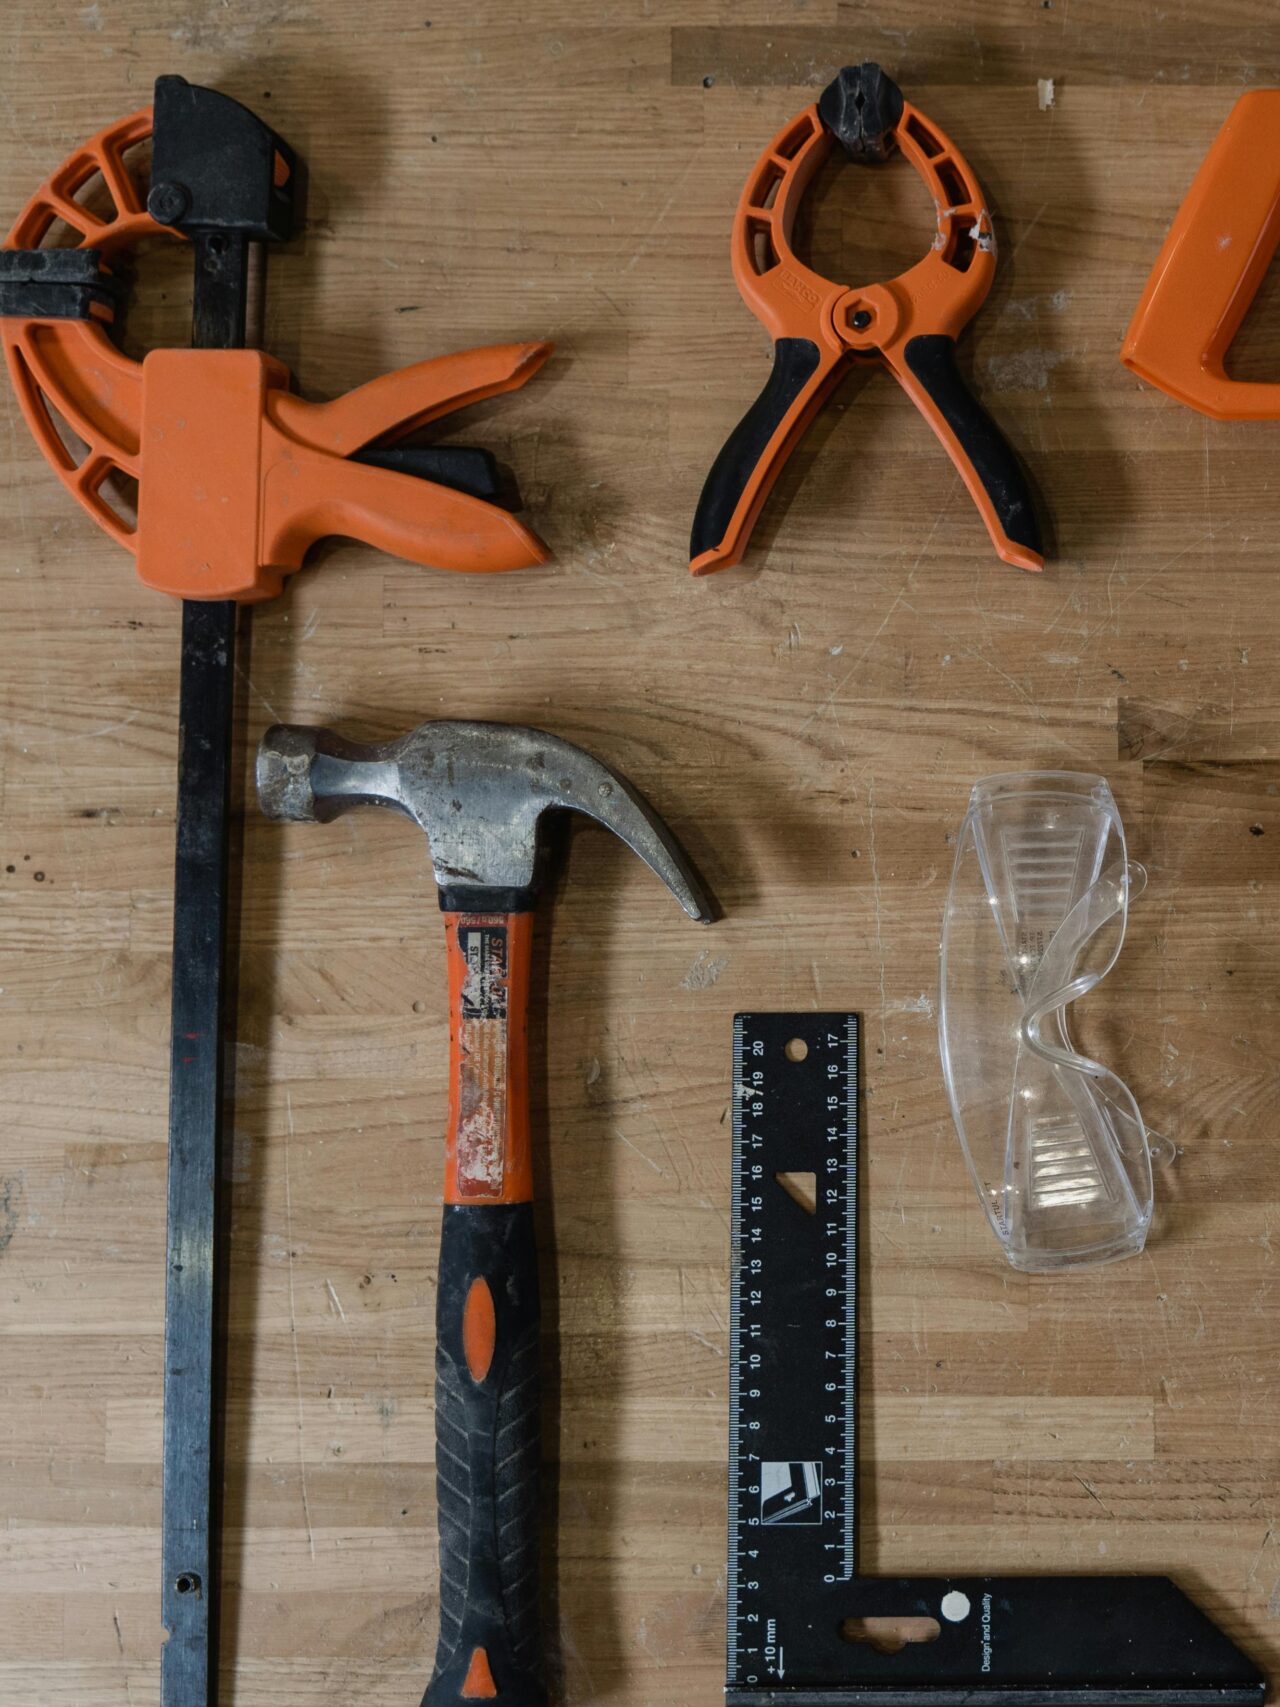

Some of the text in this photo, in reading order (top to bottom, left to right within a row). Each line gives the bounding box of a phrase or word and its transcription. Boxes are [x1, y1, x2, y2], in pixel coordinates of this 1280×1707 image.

[753, 1041, 763, 1055] 20
[828, 1034, 838, 1048] 17
[753, 1072, 763, 1086] 19
[827, 1065, 838, 1079] 16
[753, 1103, 763, 1117] 18
[827, 1096, 838, 1110] 15
[752, 1134, 762, 1148] 17
[827, 1127, 837, 1141] 14
[752, 1165, 762, 1180] 16
[827, 1158, 837, 1173] 13
[827, 1189, 837, 1204] 12
[751, 1197, 762, 1211] 15
[751, 1228, 761, 1242] 14
[827, 1223, 837, 1235] 11
[751, 1260, 761, 1274] 13
[826, 1253, 837, 1267] 10
[751, 1291, 761, 1305] 12
[825, 1319, 836, 1327] 8
[750, 1325, 760, 1337] 11
[750, 1354, 760, 1369] 10
[825, 1351, 836, 1359] 7
[750, 1389, 760, 1397] 9
[825, 1383, 836, 1391] 6
[749, 1421, 760, 1429] 8
[749, 1453, 759, 1461] 7
[749, 1485, 759, 1493] 6
[824, 1478, 835, 1486] 3
[748, 1517, 759, 1525] 5
[748, 1581, 758, 1589] 3
[824, 1574, 835, 1583] 0
[767, 1619, 776, 1643] mm
[981, 1593, 993, 1672] Design and Quality
[764, 1646, 776, 1662] 10
[747, 1675, 757, 1683] 0
